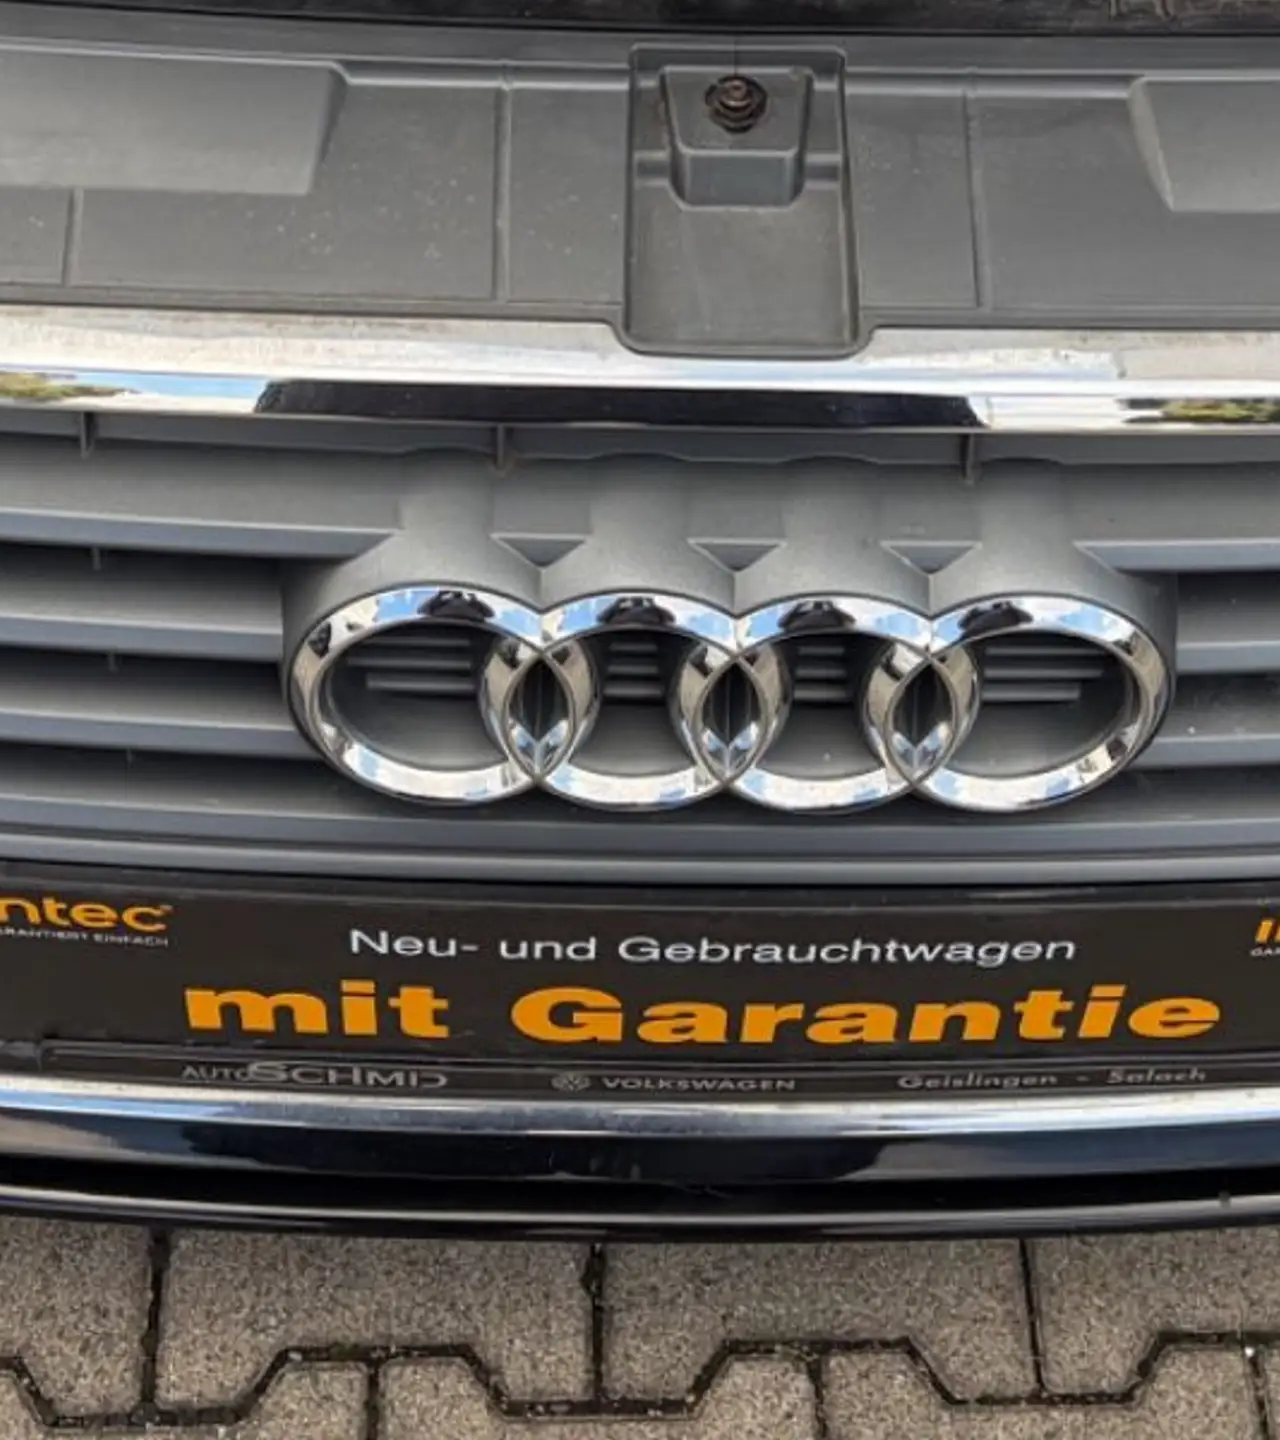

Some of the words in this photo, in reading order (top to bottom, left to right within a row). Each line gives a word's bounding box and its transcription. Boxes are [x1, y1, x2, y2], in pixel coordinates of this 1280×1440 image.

[350, 928, 479, 957] Neu-
[500, 936, 597, 960] und
[618, 935, 1075, 968] Gebrauchtwagen
[185, 979, 449, 1038] mit
[511, 984, 1221, 1044] Garantie
[601, 1077, 796, 1092] VOLKSWAGEN
[896, 1071, 1059, 1090] Geislingen
[1105, 1066, 1207, 1084] Salach
